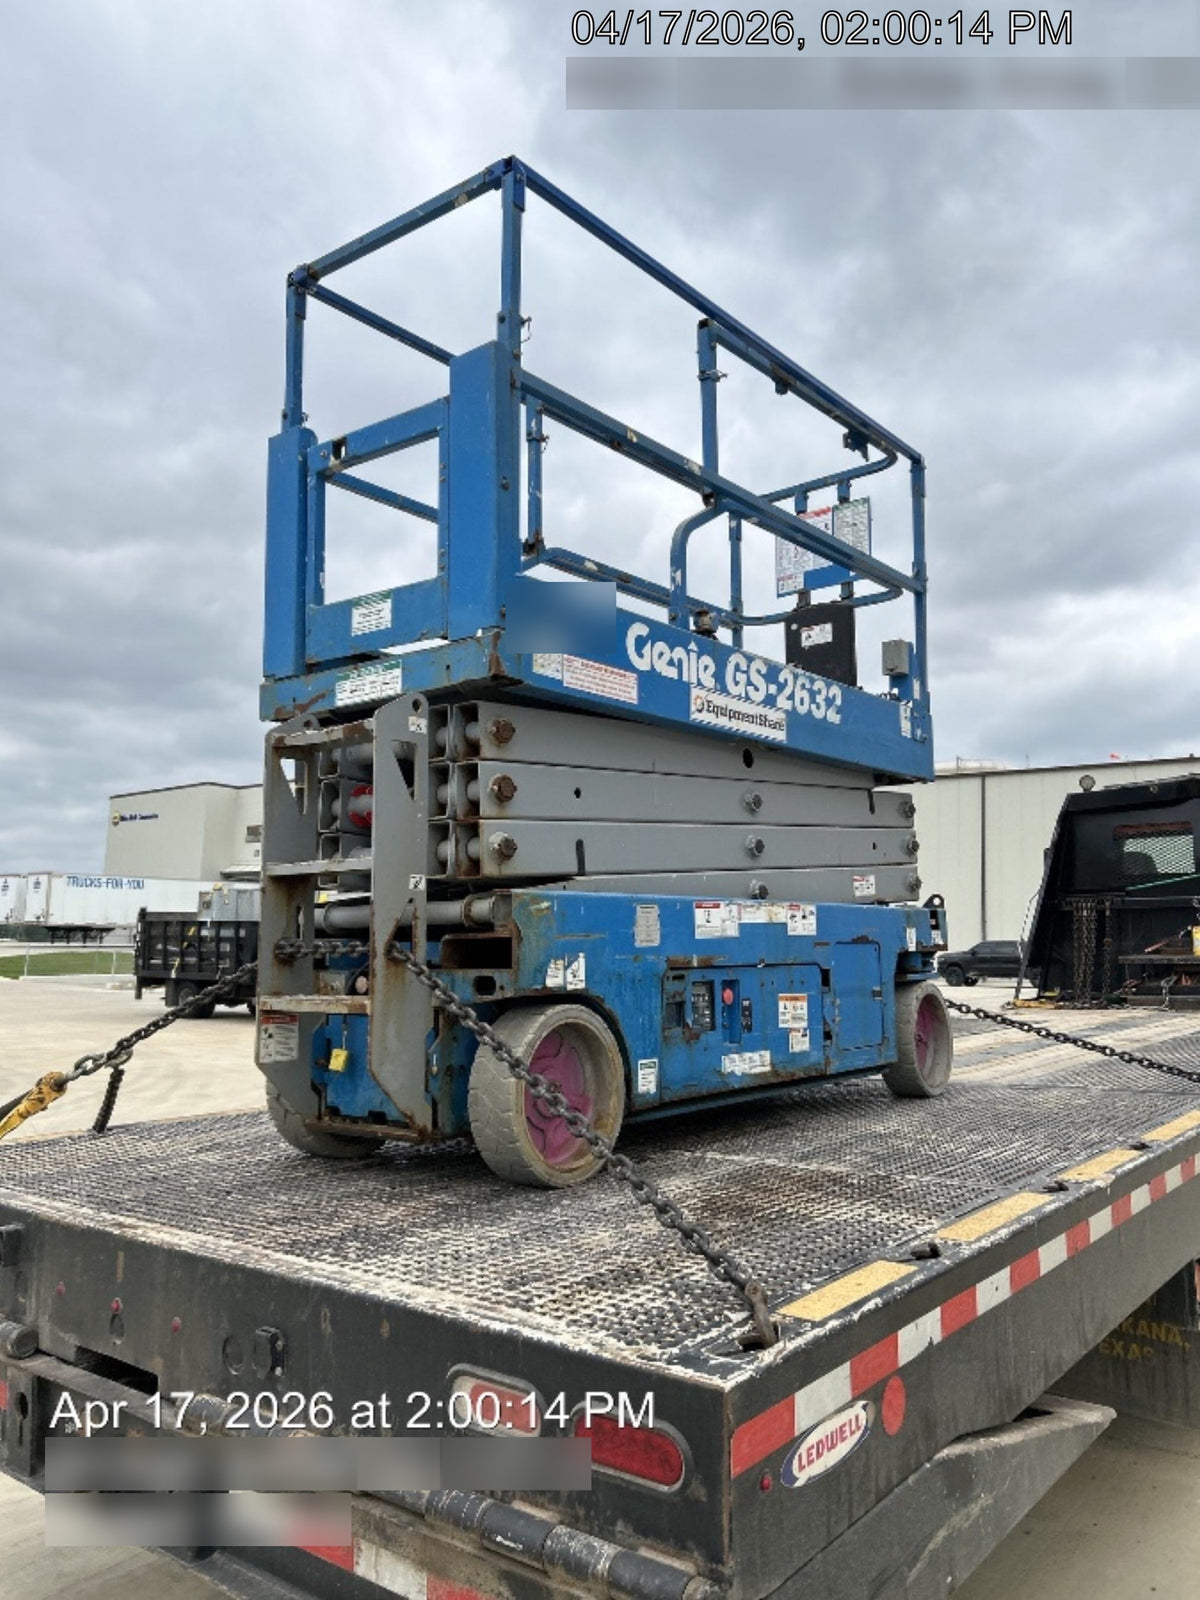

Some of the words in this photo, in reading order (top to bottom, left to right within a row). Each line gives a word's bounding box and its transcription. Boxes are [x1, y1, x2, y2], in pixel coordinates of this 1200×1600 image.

[626, 621, 717, 687] Genie
[725, 652, 842, 724] GS-2632
[705, 699, 786, 732] EquipmentShare
[66, 876, 145, 890] TRUCKS-FOR-YOU
[1098, 1338, 1156, 1362] EXAS
[1120, 1317, 1191, 1353] KANA,
[796, 1413, 864, 1473] LEDWELL
